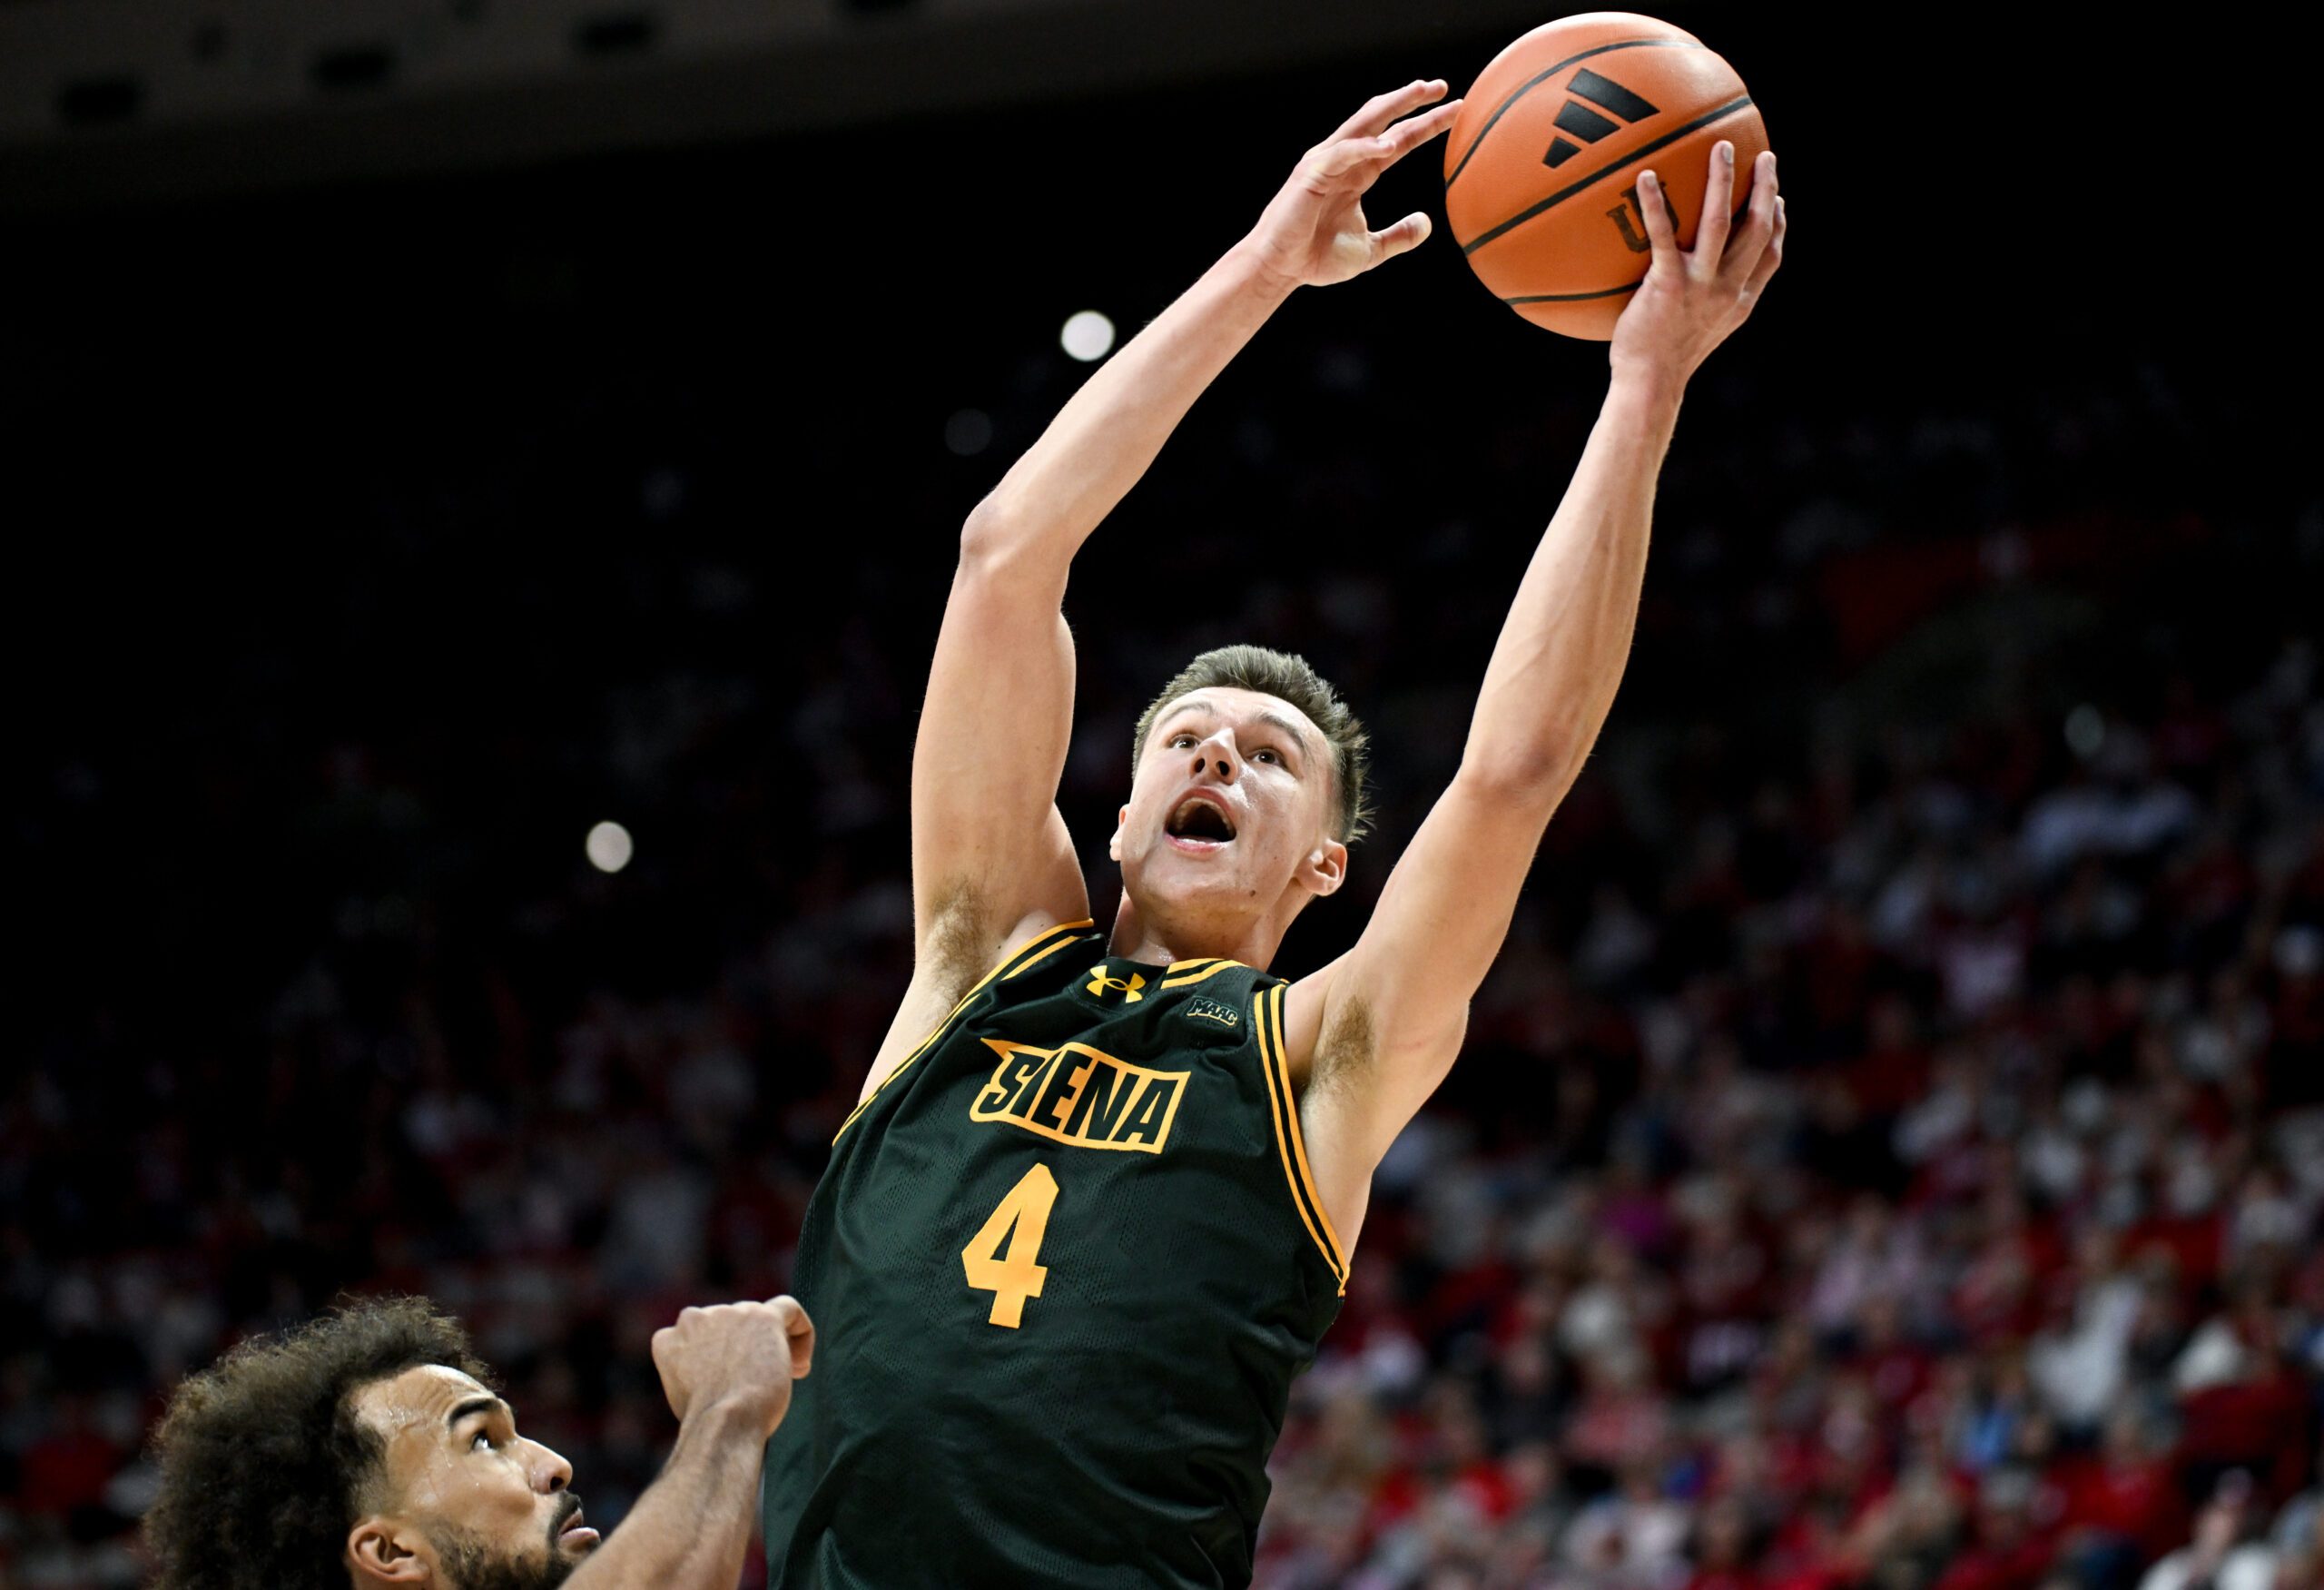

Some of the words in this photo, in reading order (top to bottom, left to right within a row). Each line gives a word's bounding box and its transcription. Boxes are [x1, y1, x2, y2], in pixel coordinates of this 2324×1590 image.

[1187, 999, 1238, 1026] MAAC
[978, 1048, 1180, 1146] SIENA
[961, 1162, 1059, 1329] 4
